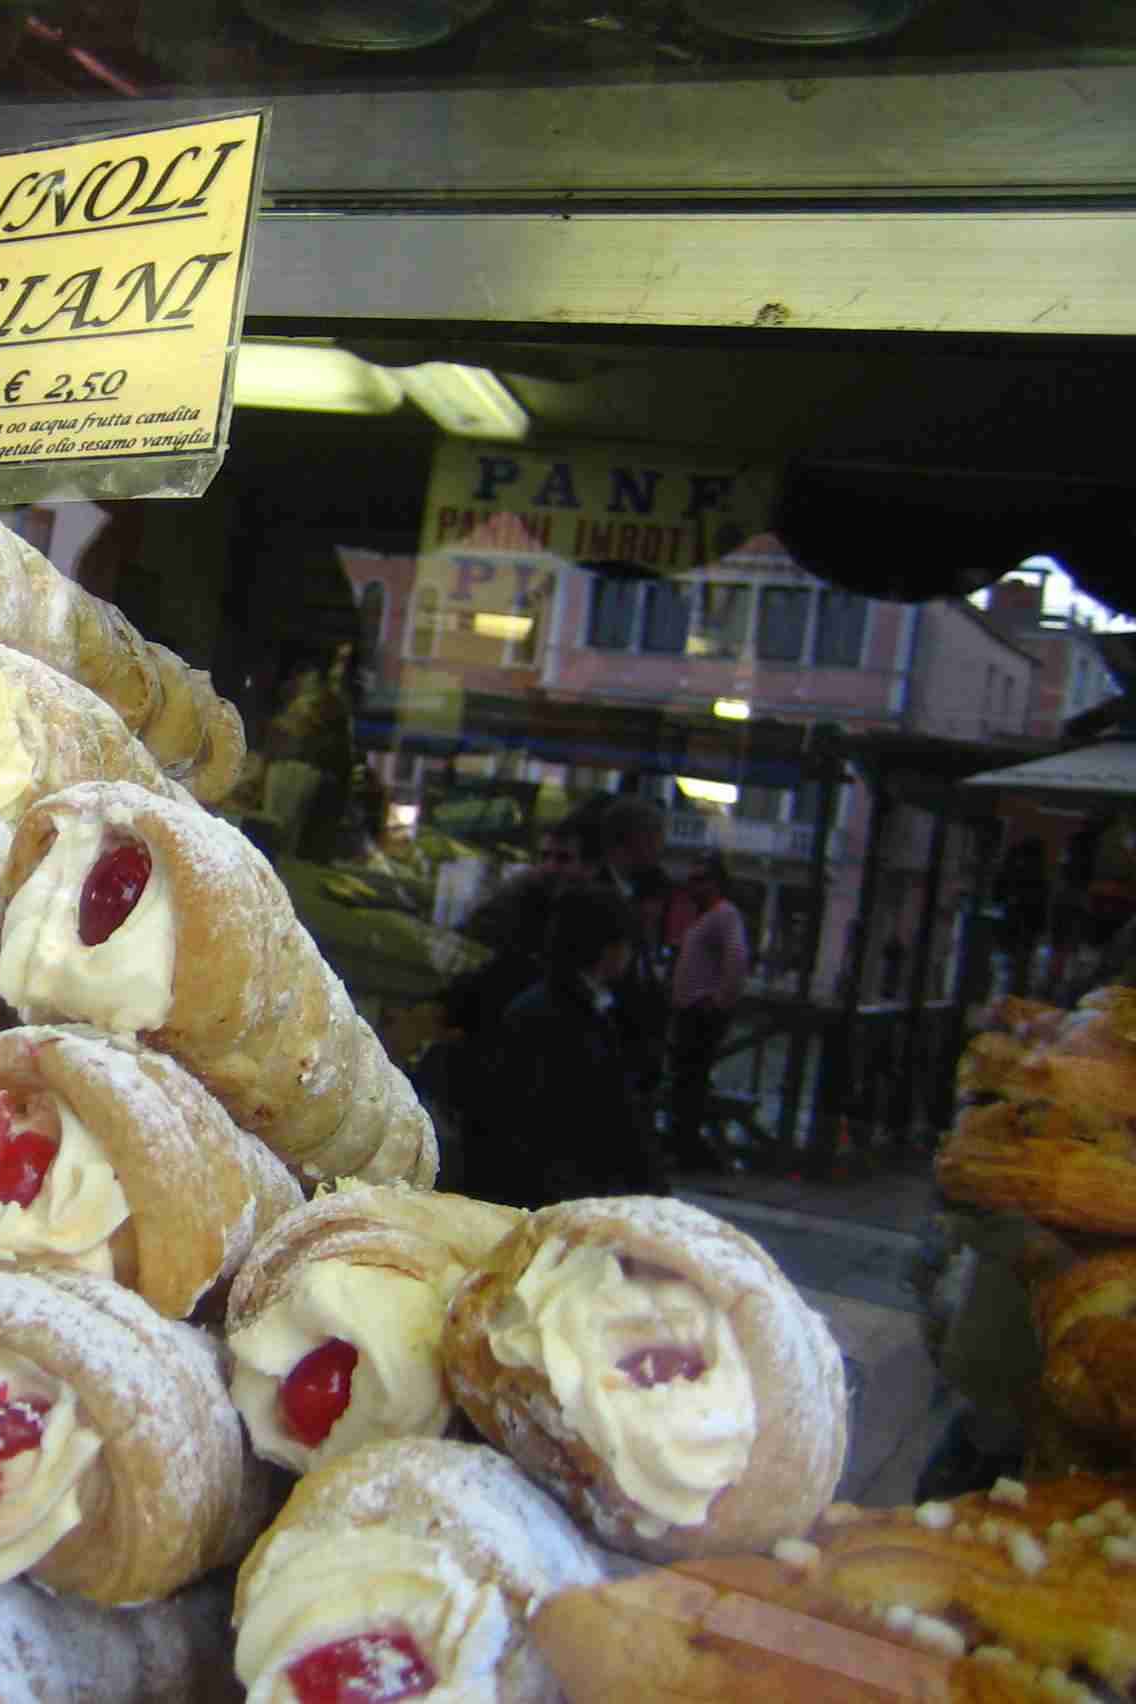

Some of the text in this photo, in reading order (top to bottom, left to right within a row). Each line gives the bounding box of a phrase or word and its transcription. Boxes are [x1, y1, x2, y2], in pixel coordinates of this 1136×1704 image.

[3, 369, 31, 403] €
[43, 368, 128, 402] 2,50
[29, 418, 79, 436] acqua
[77, 411, 133, 434] frutta
[135, 404, 202, 424] candita
[45, 436, 76, 454] olio
[77, 437, 138, 453] sesamo
[141, 427, 213, 452] vaniglia
